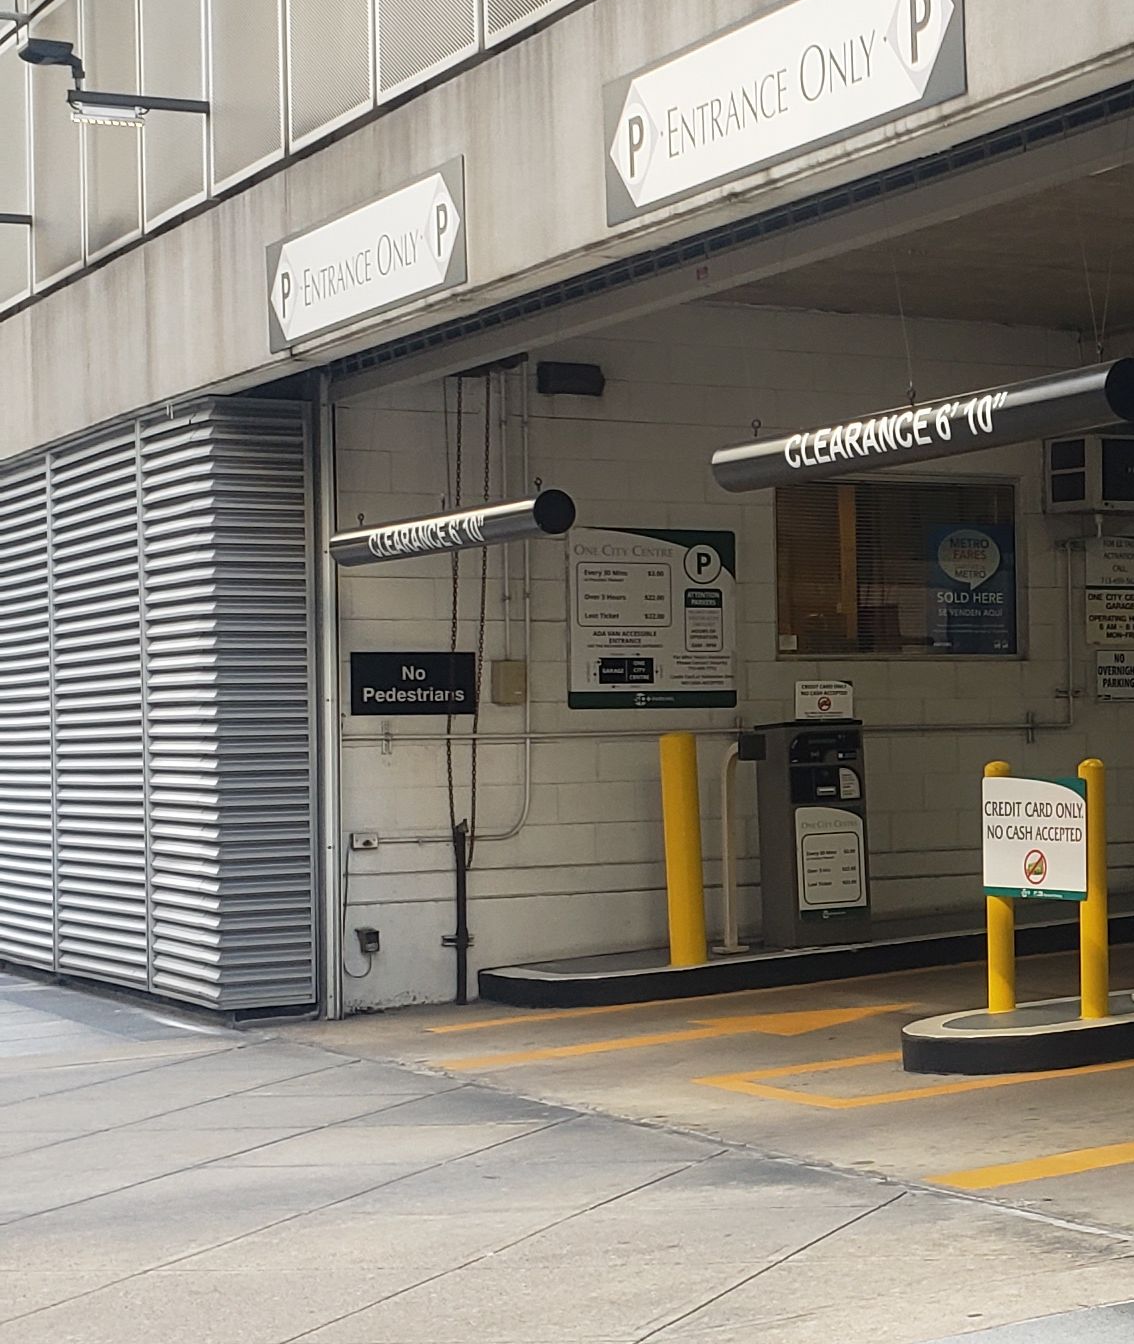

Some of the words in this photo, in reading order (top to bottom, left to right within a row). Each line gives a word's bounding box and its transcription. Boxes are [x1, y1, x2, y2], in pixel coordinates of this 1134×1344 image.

[628, 115, 644, 178] P
[666, 68, 788, 158] ENTRANCE
[800, 29, 876, 102] ONLY
[281, 271, 291, 319] P
[304, 249, 372, 307] ENTRANCE
[377, 229, 418, 275] ONLY
[436, 203, 448, 257] P
[785, 407, 933, 469] CLEARANCE
[368, 521, 452, 558] CLEARANCE
[950, 538, 990, 549] METRO
[574, 544, 598, 556] ONE
[602, 544, 628, 557] CITY
[632, 545, 673, 558] CENTRE
[953, 549, 986, 559] FARES
[697, 552, 711, 575] P
[1112, 564, 1128, 573] CALL
[584, 569, 602, 577] Every
[955, 569, 986, 579] METRO
[936, 592, 969, 604] SOLD
[973, 592, 1005, 604] HERE
[1087, 593, 1103, 601] ONE
[1105, 593, 1122, 601] CITY
[1105, 602, 1134, 610] GARAGE
[949, 608, 981, 617] VENDEN
[1088, 615, 1127, 623] OPERATING
[1114, 653, 1125, 664] NO
[402, 665, 426, 681] No
[984, 801, 1022, 817] CREDIT
[1025, 802, 1053, 817] CARD
[1056, 802, 1084, 819] ONLY.
[987, 824, 1003, 839] NO
[1006, 825, 1033, 840] CASH
[1035, 826, 1083, 842] ACCEPTED
